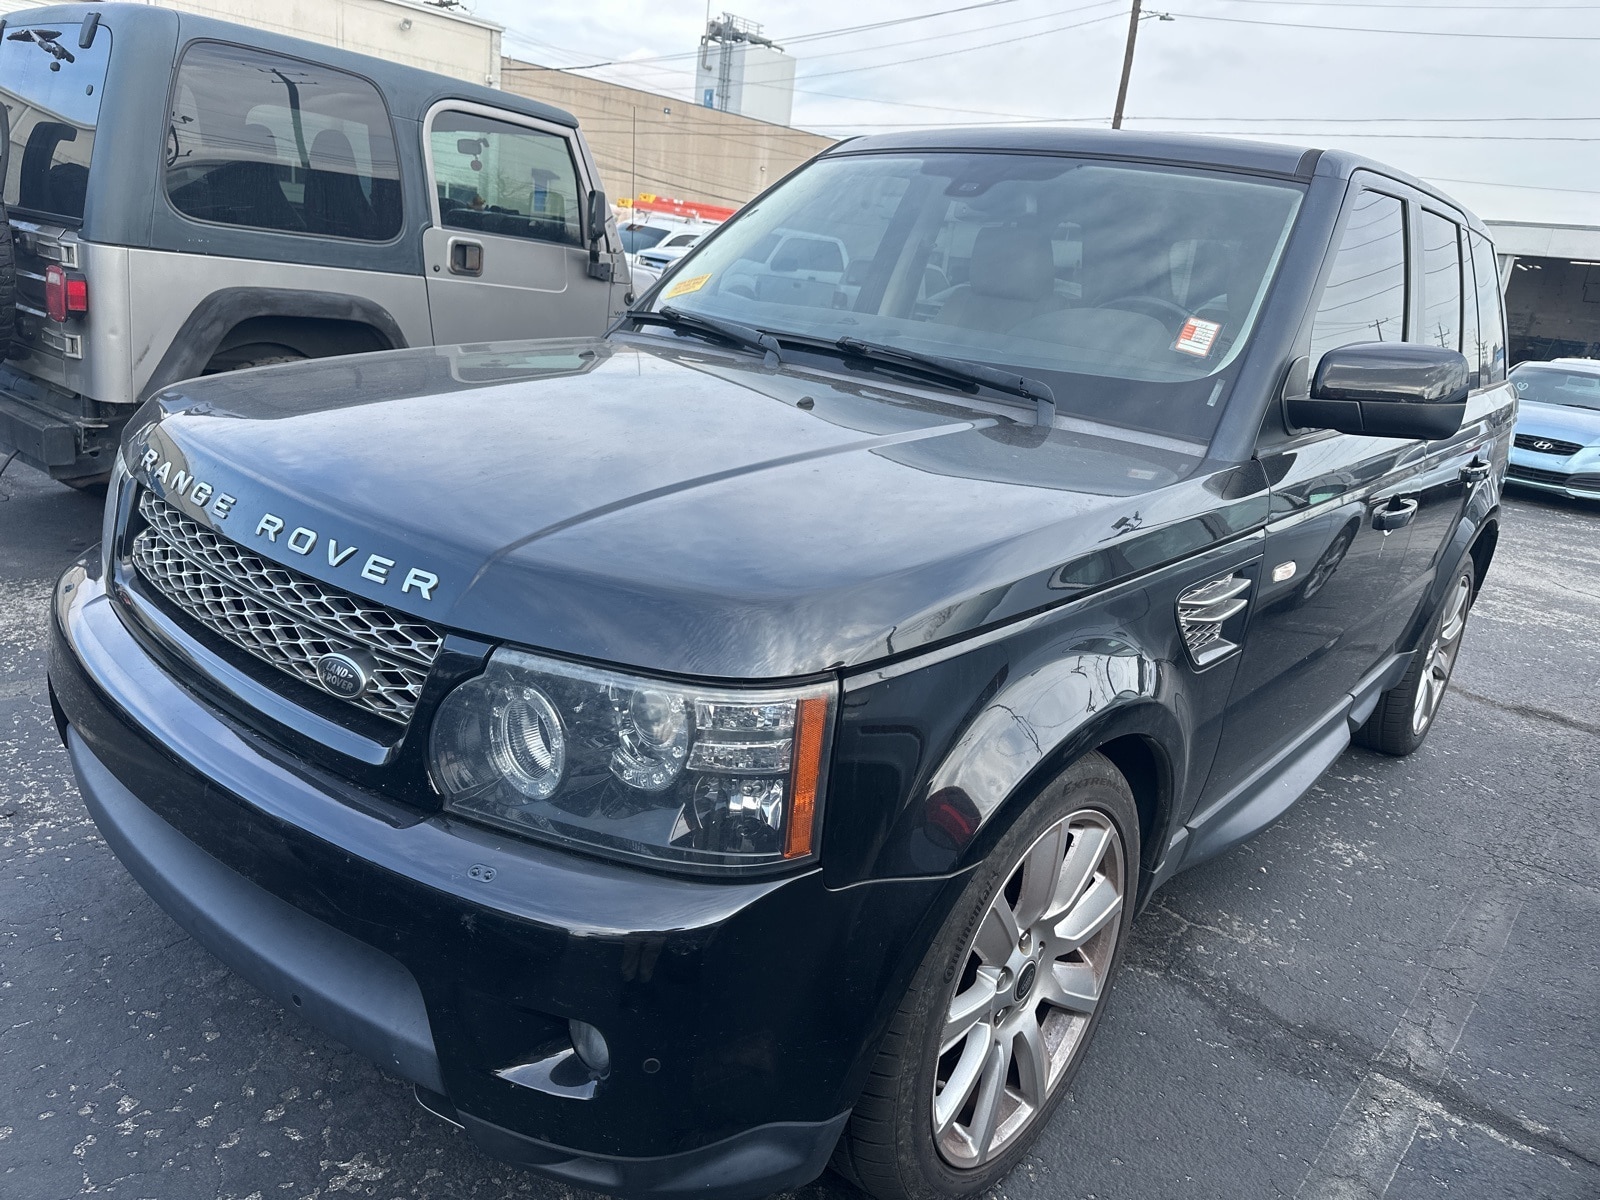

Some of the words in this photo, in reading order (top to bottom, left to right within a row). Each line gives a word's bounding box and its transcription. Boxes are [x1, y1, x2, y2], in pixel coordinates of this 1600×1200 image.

[140, 448, 237, 520] RANGE
[255, 513, 440, 601] ROVER
[325, 661, 349, 678] LAND
[326, 671, 354, 691] ROVER
